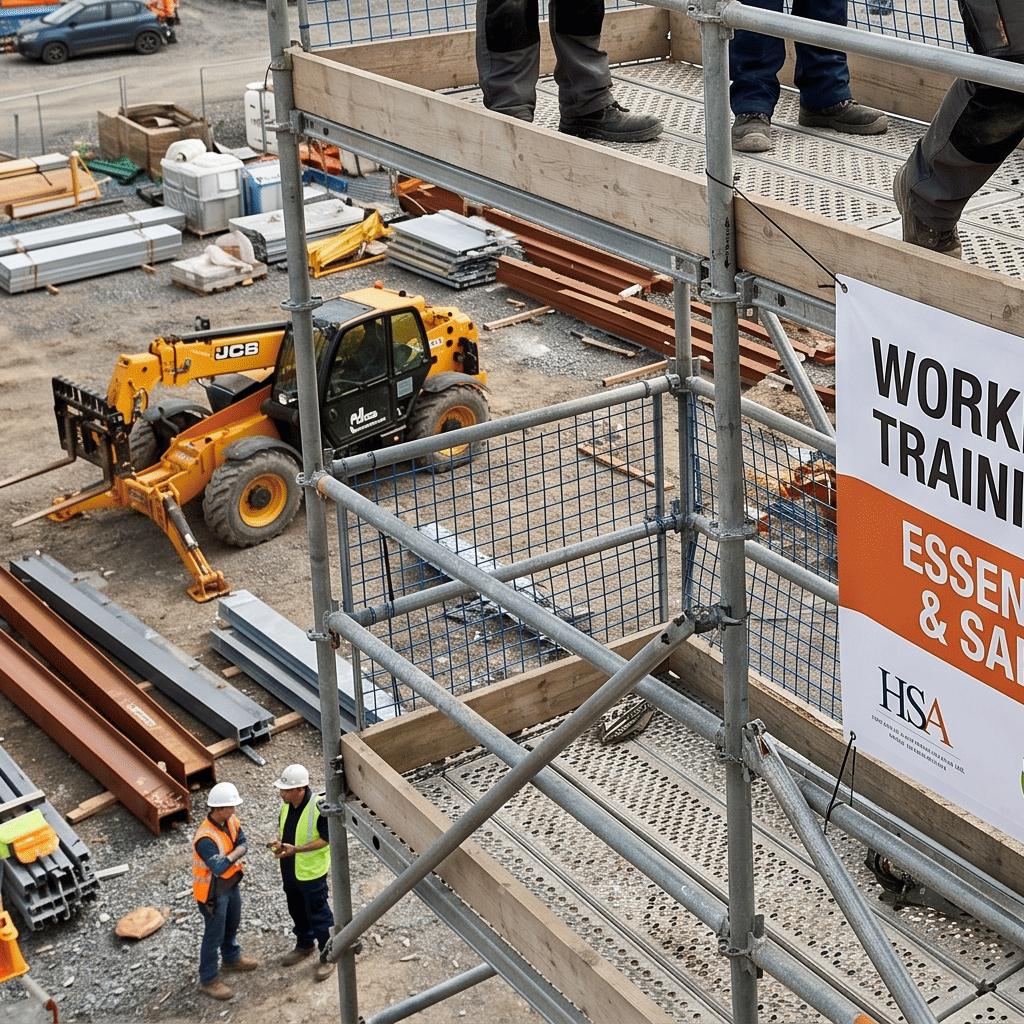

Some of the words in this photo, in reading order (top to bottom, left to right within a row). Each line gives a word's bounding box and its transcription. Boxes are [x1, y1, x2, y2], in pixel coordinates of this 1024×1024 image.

[215, 341, 259, 360] JCB
[919, 589, 949, 647] &
[878, 666, 954, 749] HSA
